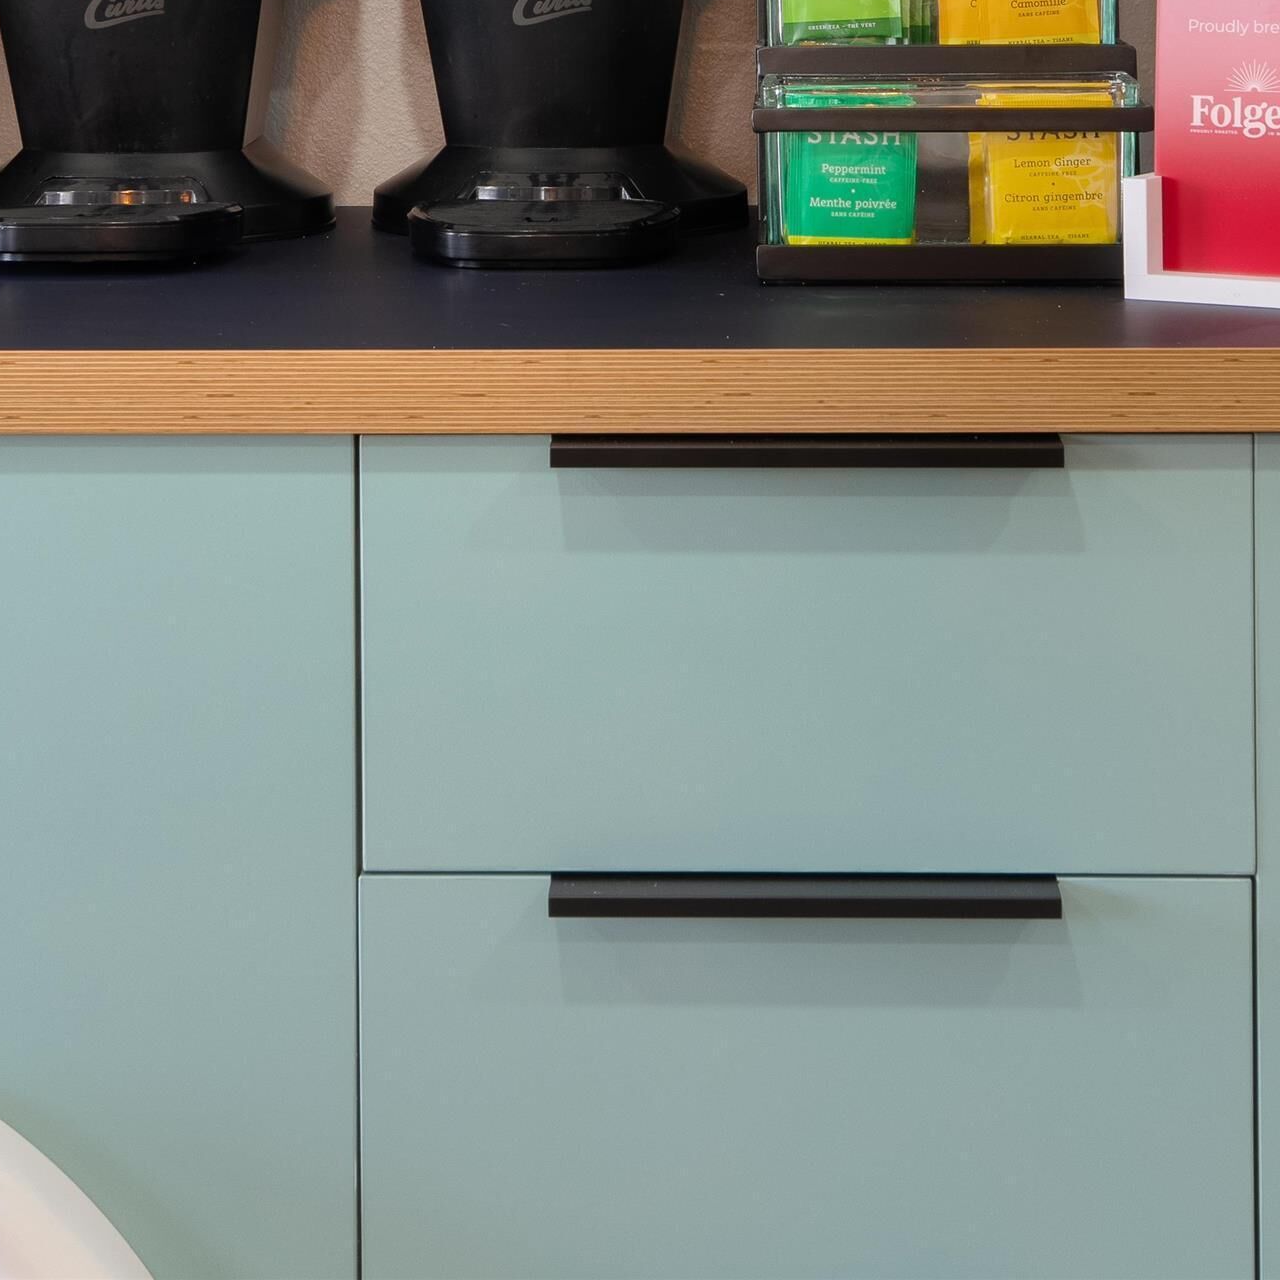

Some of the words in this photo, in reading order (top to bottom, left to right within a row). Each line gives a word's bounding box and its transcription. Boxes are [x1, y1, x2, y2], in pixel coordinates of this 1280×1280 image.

[1188, 19, 1249, 37] Proudly
[1014, 159, 1050, 168] Lemon
[1054, 157, 1091, 168] Ginger
[821, 164, 886, 175] Peppermint
[1004, 193, 1039, 203] Citron
[1044, 191, 1103, 203] gingembre
[809, 197, 851, 208] Menthe
[855, 199, 897, 210] poivrée
